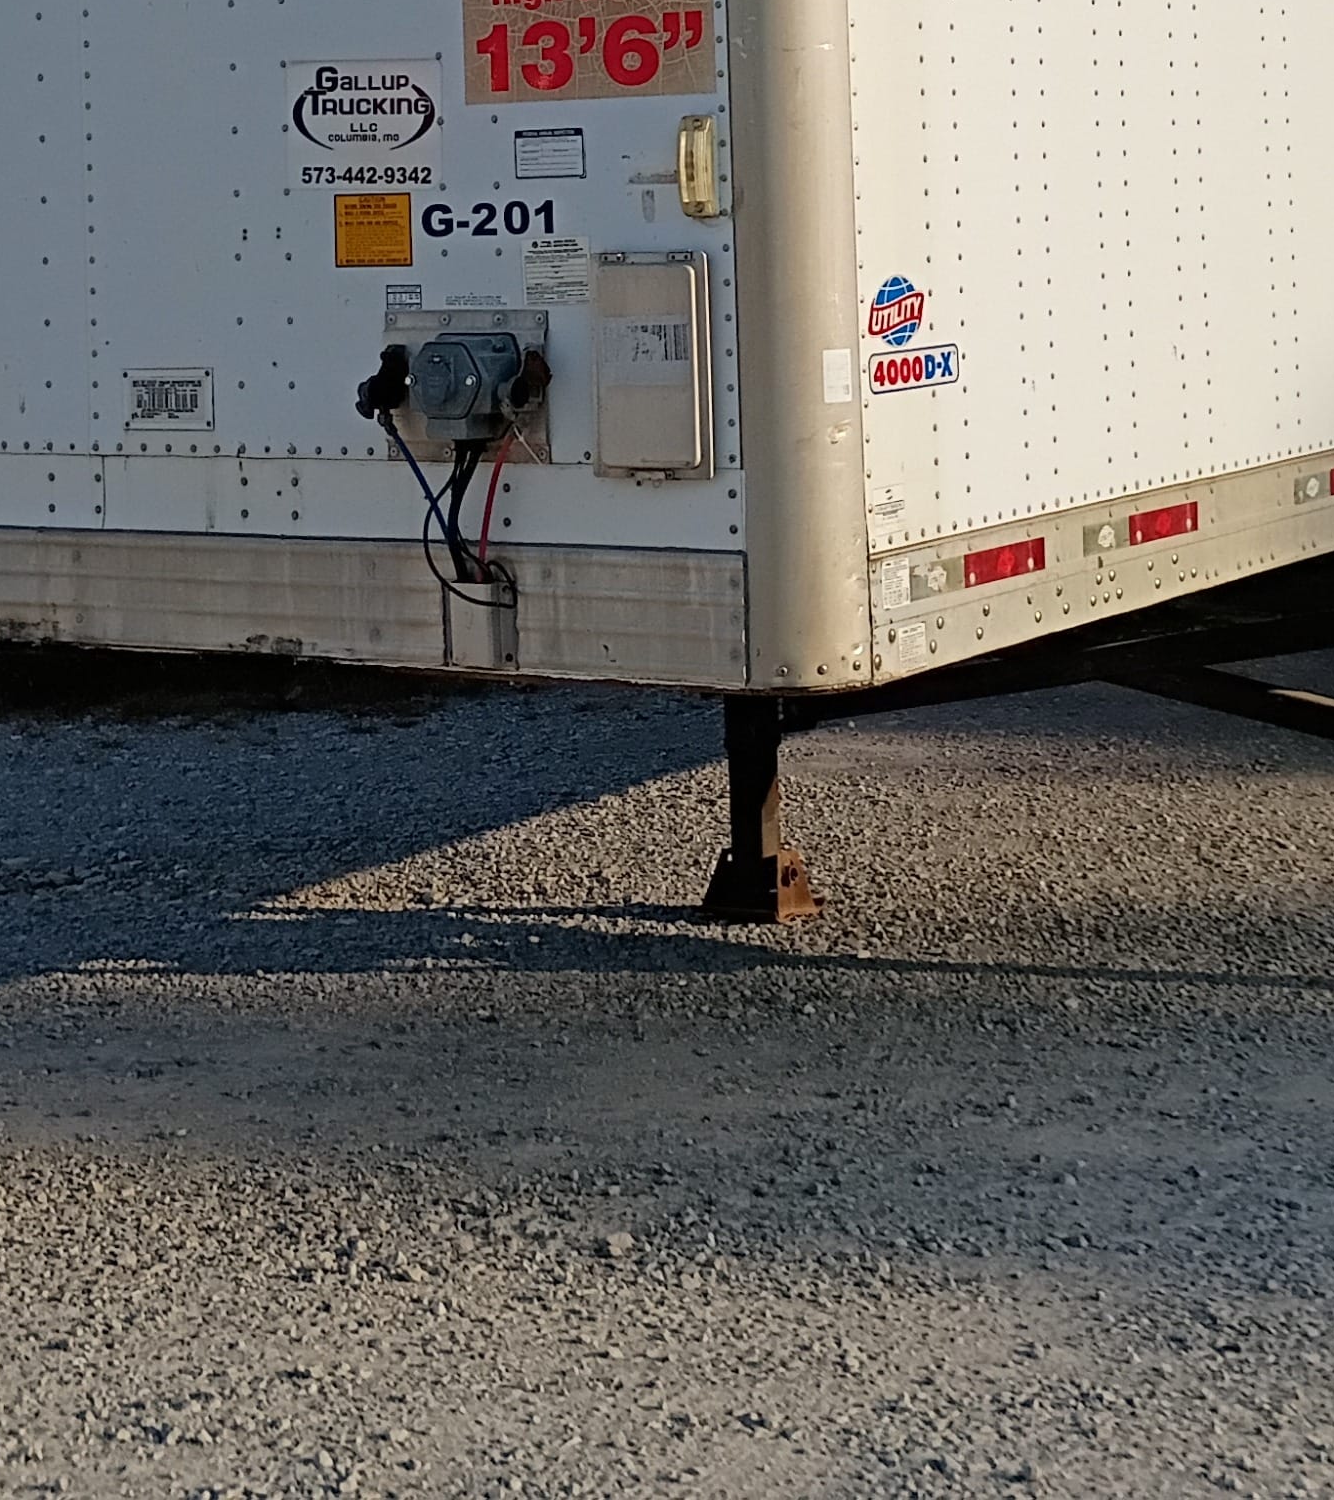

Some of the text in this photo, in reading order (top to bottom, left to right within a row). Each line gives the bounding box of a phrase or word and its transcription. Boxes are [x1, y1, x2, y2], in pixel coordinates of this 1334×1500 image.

[350, 123, 378, 133] LLC
[302, 166, 432, 185] 573-442-9342
[421, 199, 555, 238] G-201
[871, 296, 922, 332] UTILITY
[873, 351, 954, 387] 4000D-X
